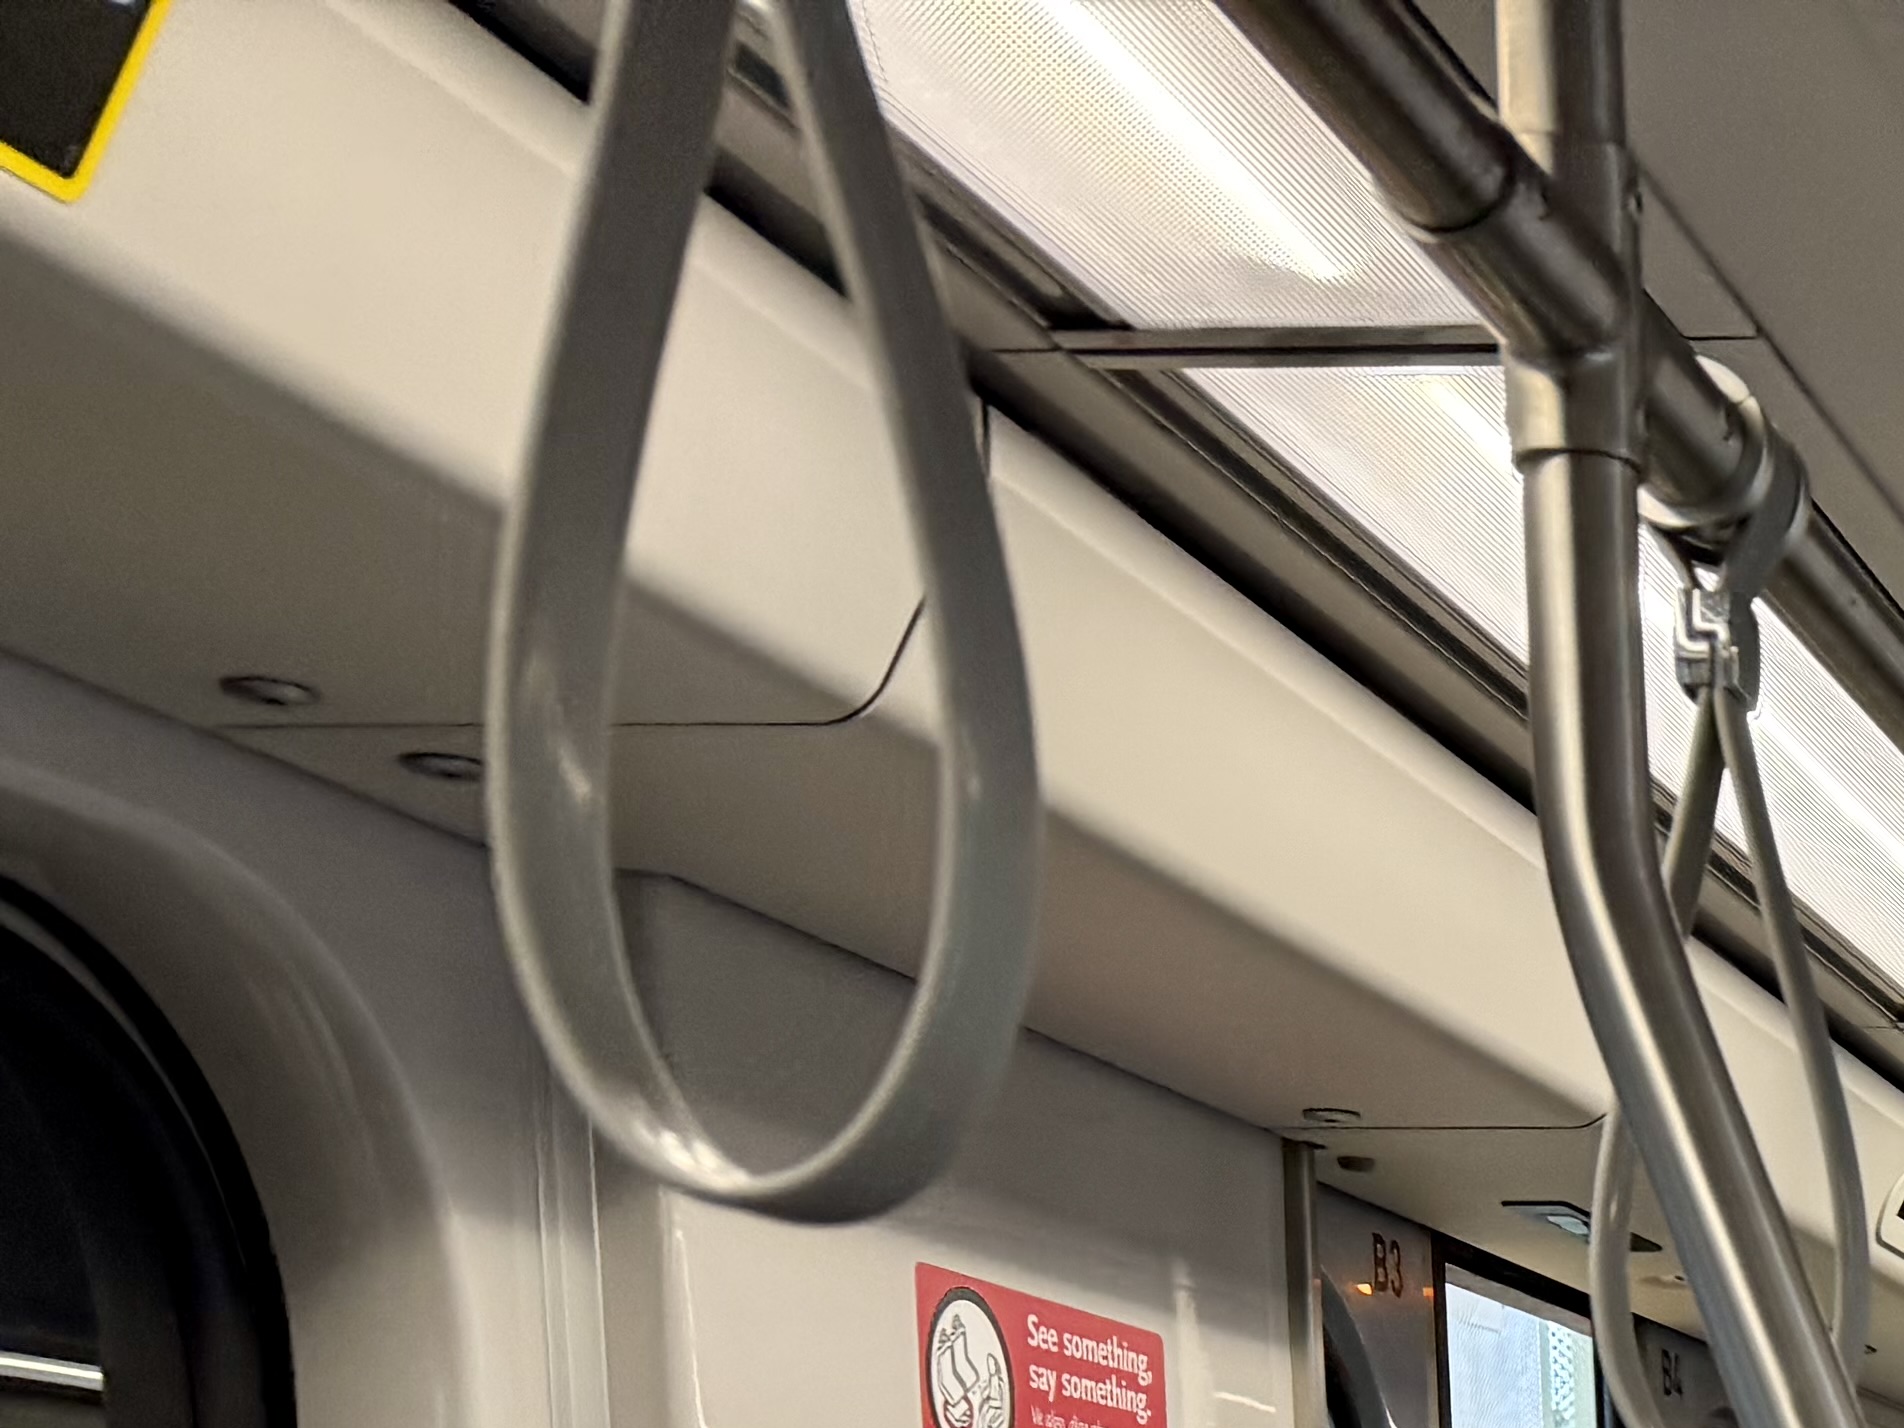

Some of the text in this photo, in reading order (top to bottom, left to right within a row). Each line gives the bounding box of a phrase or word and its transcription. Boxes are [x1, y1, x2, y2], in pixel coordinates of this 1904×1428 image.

[1372, 1232, 1403, 1298] B3
[1027, 1314, 1153, 1387] See something,
[1029, 1364, 1152, 1425] say something.
